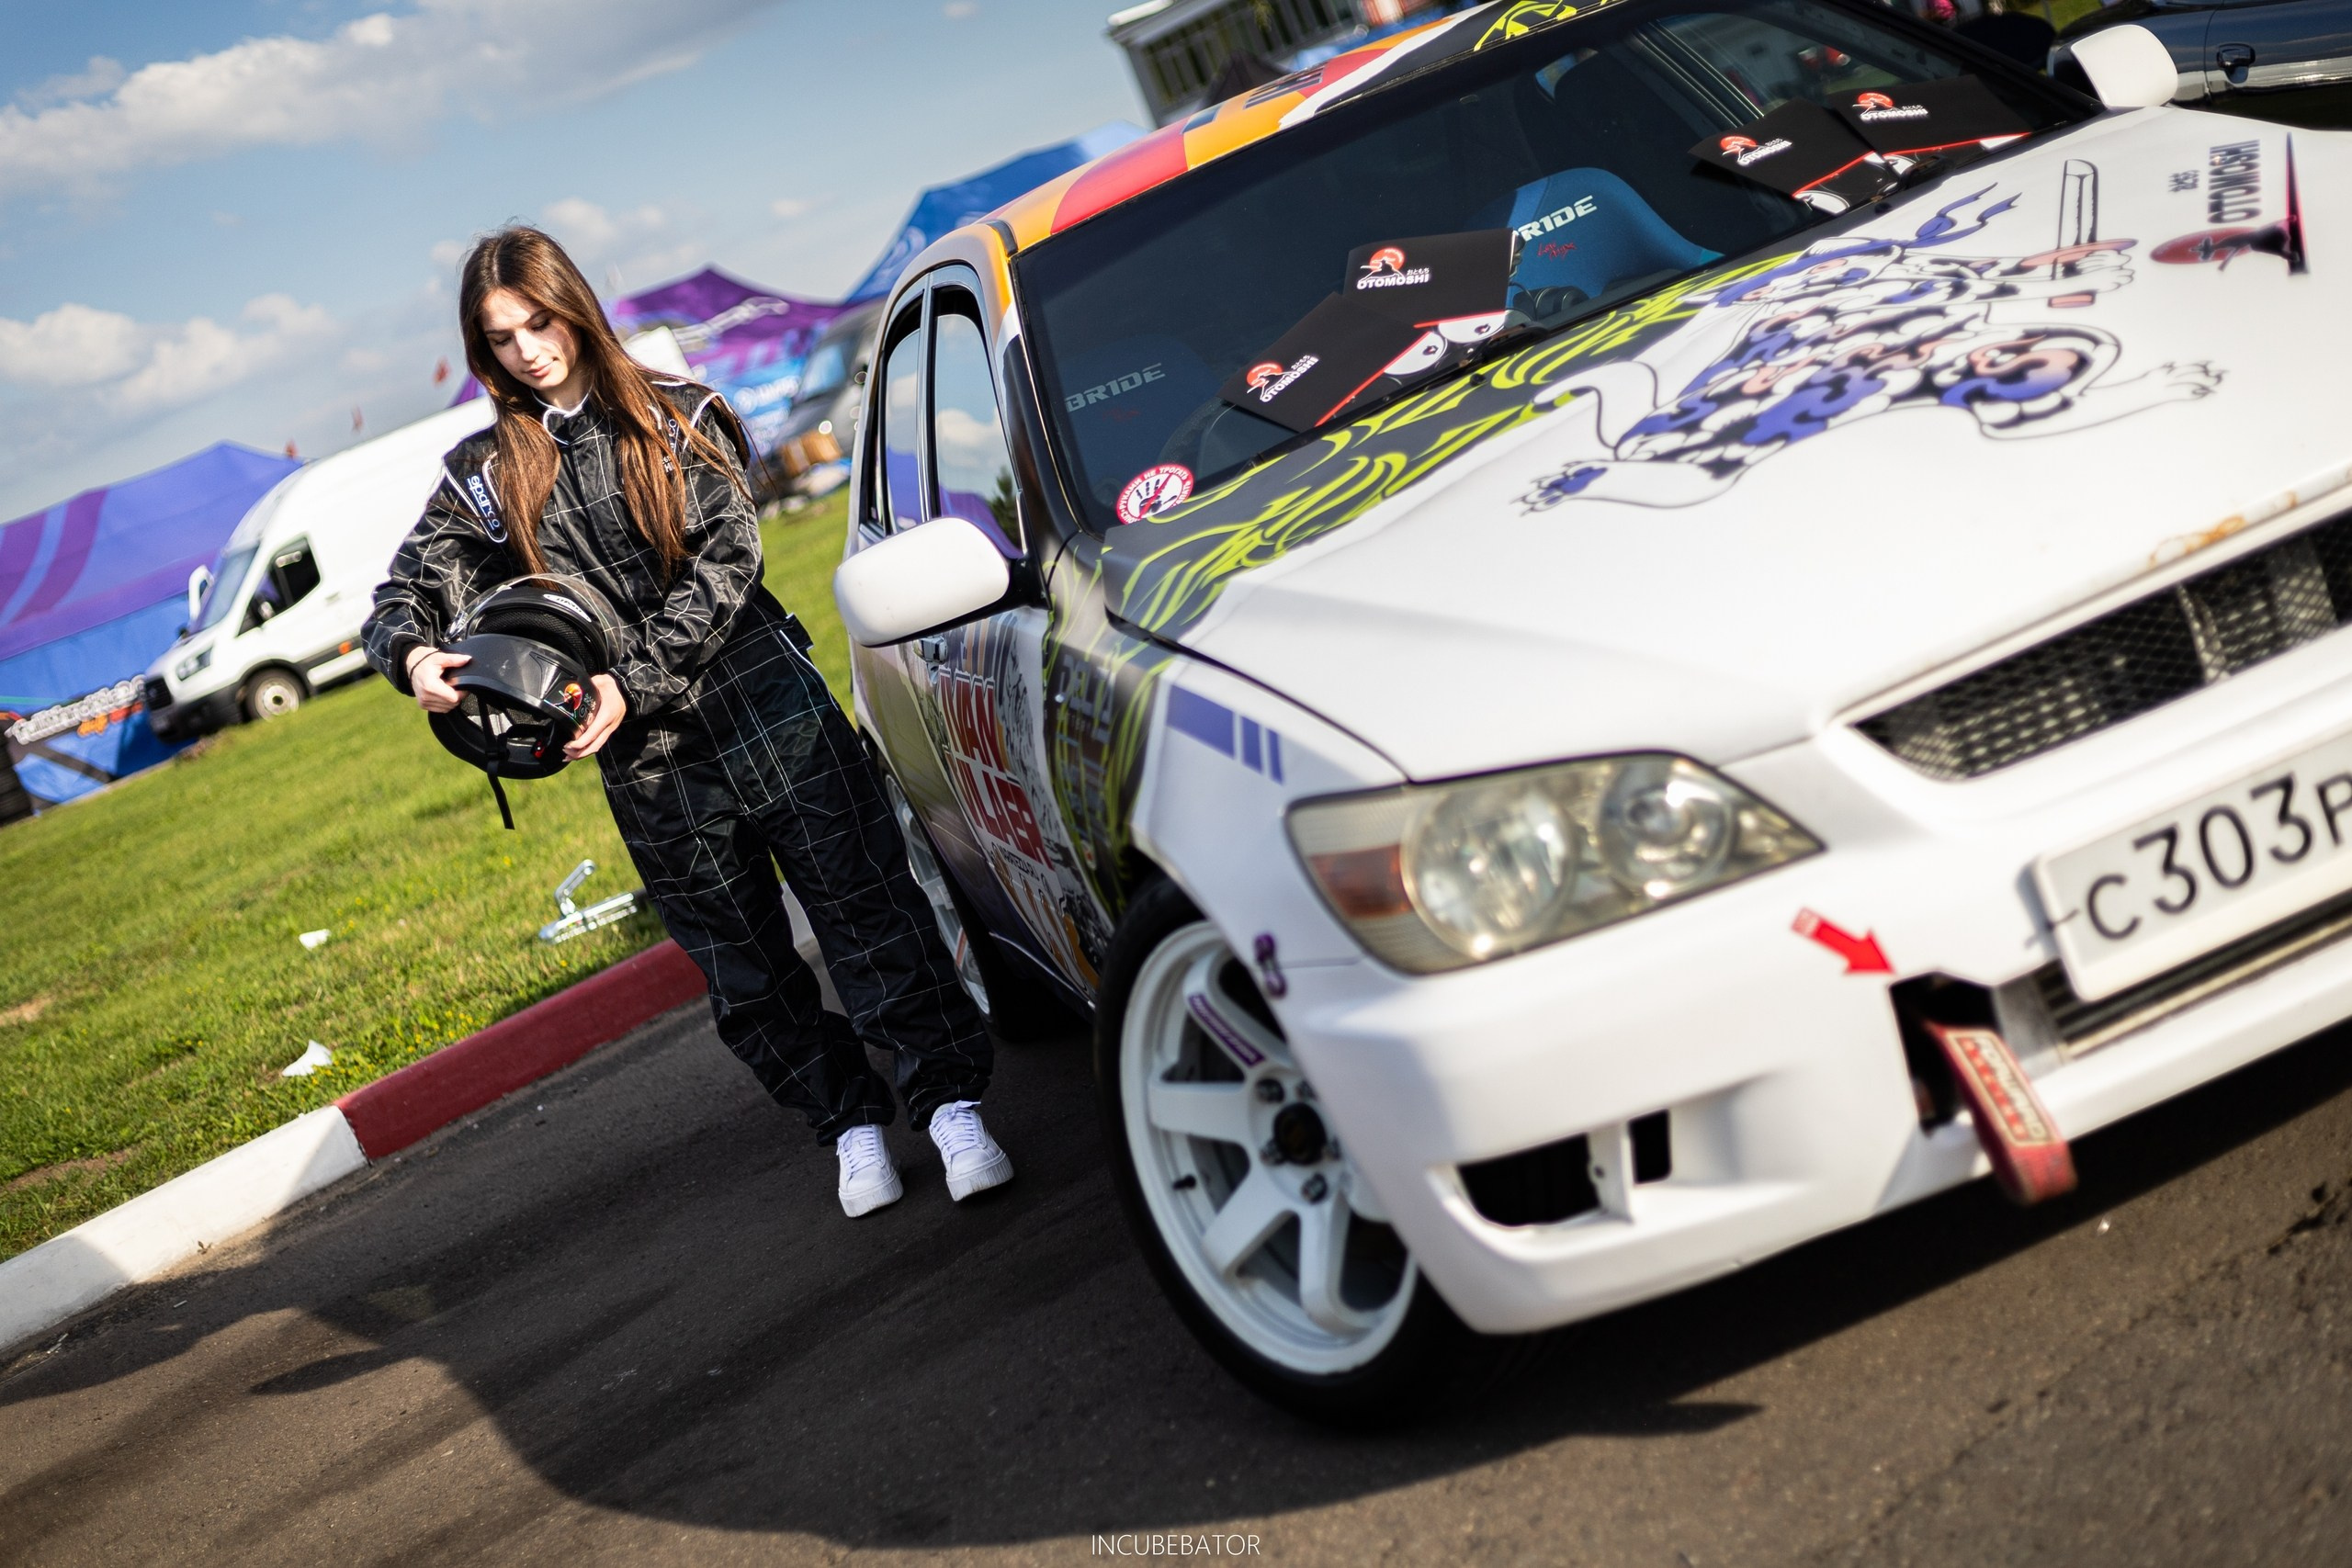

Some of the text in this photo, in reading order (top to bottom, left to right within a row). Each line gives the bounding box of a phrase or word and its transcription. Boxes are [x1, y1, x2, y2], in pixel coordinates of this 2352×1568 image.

[2208, 140, 2261, 223] OTOMOSHI
[1512, 195, 1597, 242] RIDE
[1357, 274, 1430, 289] OTOMOSHI
[1065, 363, 1166, 412] BRIDE
[1261, 356, 1319, 402] OTOMOSHI
[939, 671, 1006, 773] IVAN
